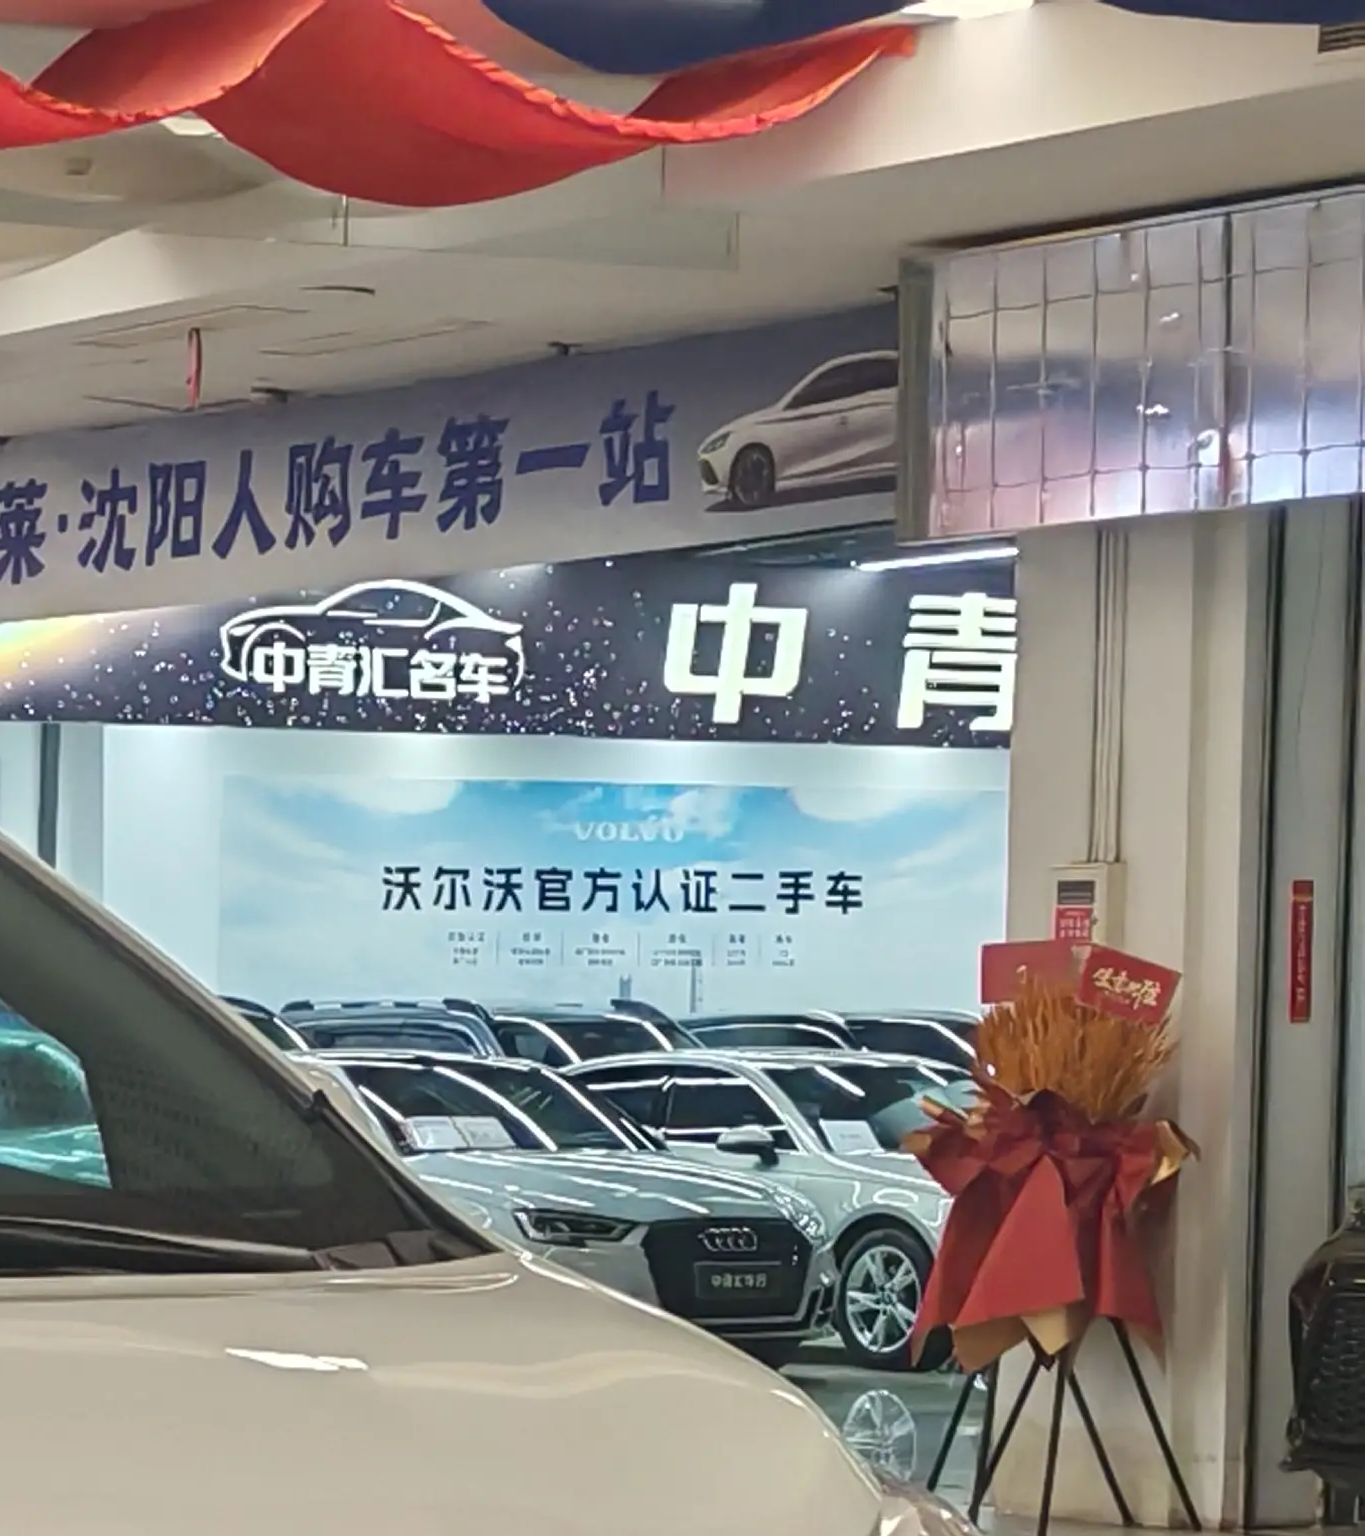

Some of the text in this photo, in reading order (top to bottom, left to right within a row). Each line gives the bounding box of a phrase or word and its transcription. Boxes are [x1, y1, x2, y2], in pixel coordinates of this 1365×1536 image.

[251, 640, 510, 702] 中青汇名车
[663, 582, 1019, 733] 中青
[380, 865, 866, 916] 沃尔沃官方认证二手车
